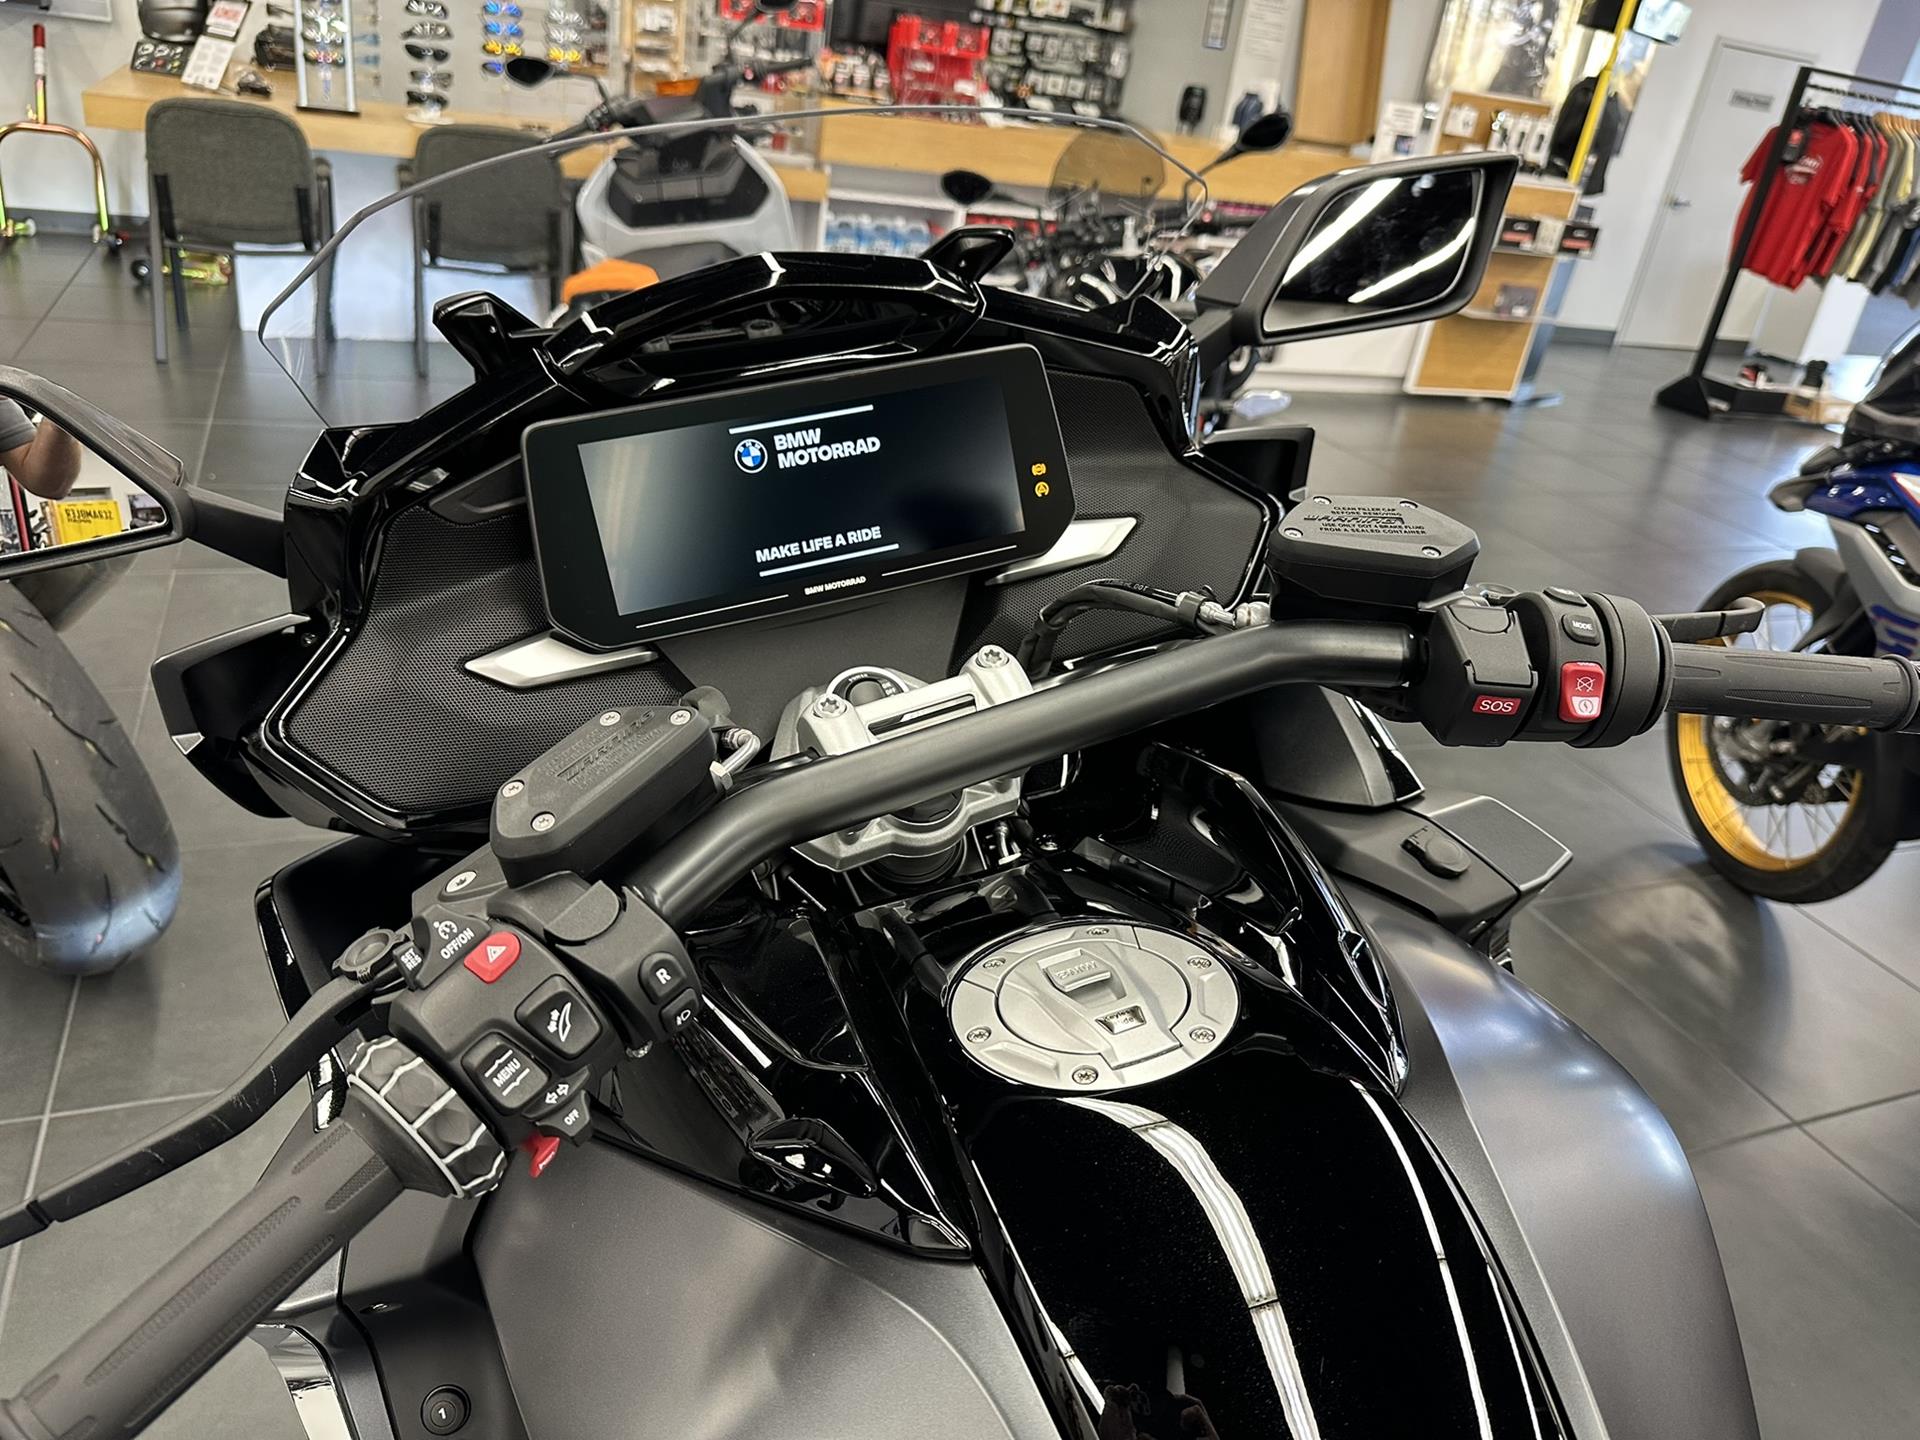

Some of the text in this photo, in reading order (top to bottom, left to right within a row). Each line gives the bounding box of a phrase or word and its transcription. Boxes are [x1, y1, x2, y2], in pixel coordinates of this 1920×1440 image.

[773, 427, 821, 451] BMW
[777, 436, 881, 469] MOTORRAD
[1303, 514, 1397, 525] WARNING
[755, 525, 882, 563] MAKE LIFE A RIDE
[804, 575, 867, 596] BMW MOTORRAD
[1571, 620, 1593, 631] MODE
[1479, 699, 1514, 713] SOS
[440, 927, 475, 960] OFF/ON
[400, 947, 416, 964] SET
[406, 954, 423, 971] RES
[655, 968, 672, 984] R
[492, 1058, 521, 1087] MENU
[564, 1109, 579, 1126] OFF
[438, 1407, 447, 1420] 1
